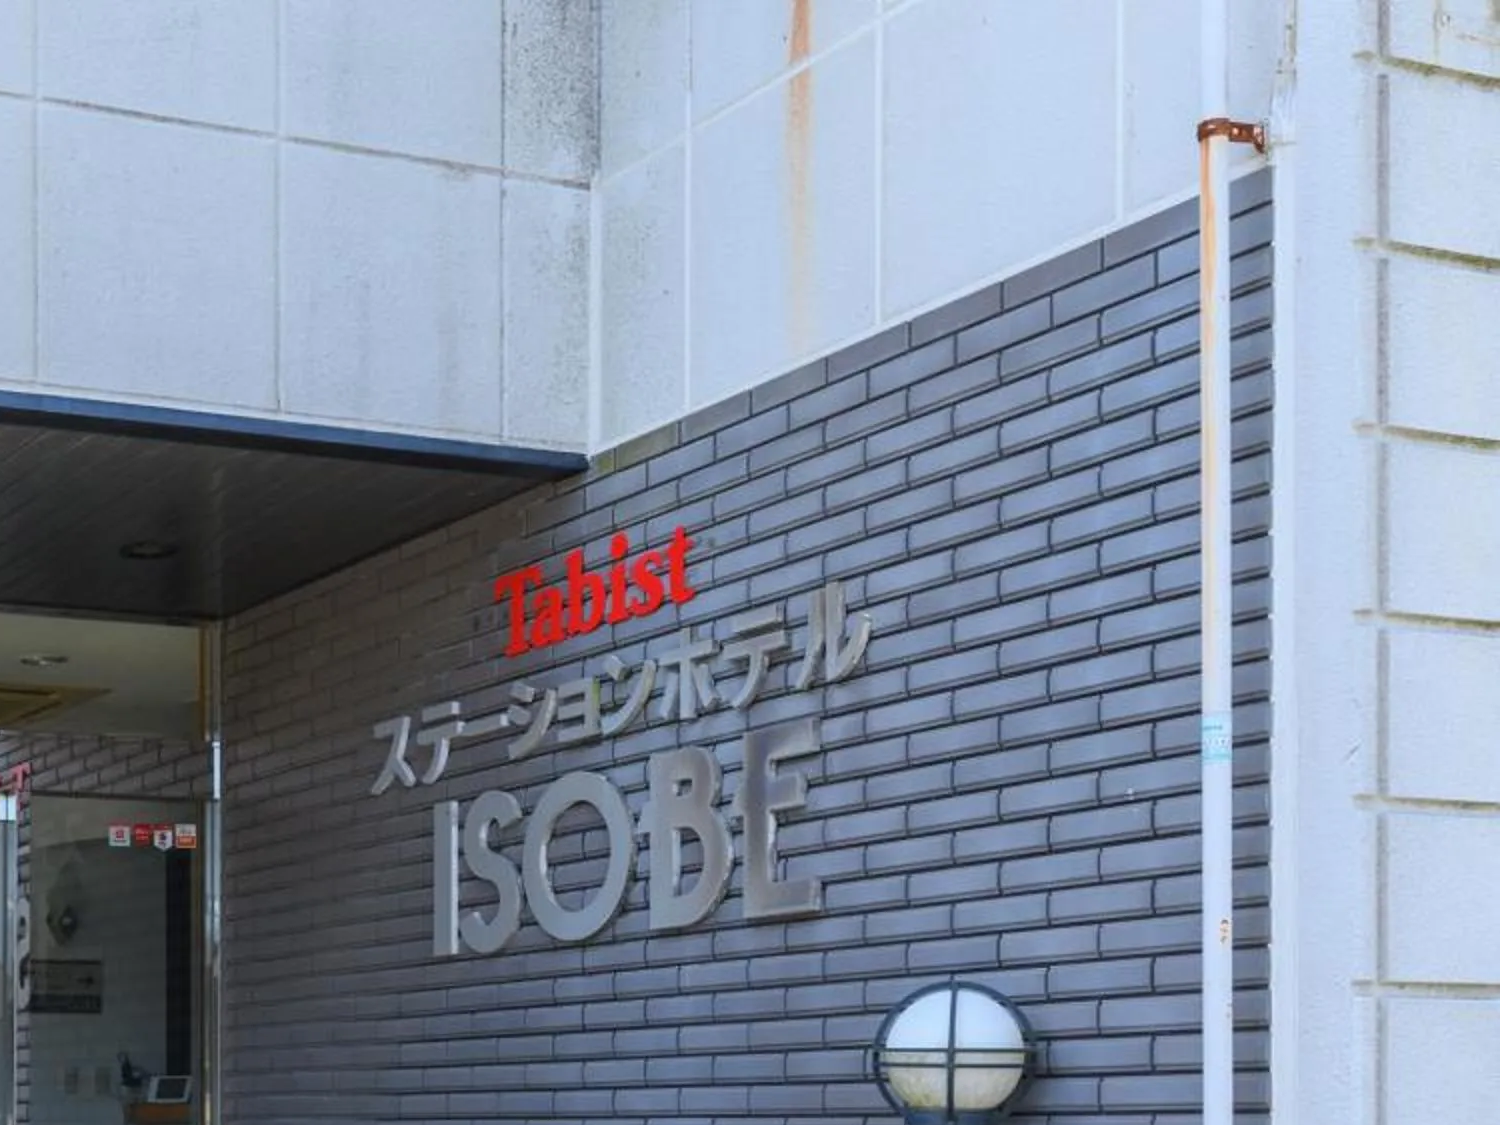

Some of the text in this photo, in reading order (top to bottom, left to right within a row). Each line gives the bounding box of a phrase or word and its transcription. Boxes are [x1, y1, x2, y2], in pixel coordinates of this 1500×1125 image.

[369, 580, 873, 796] ステーションホテル
[494, 525, 695, 658] Tabist
[433, 718, 823, 956] ISOBE
